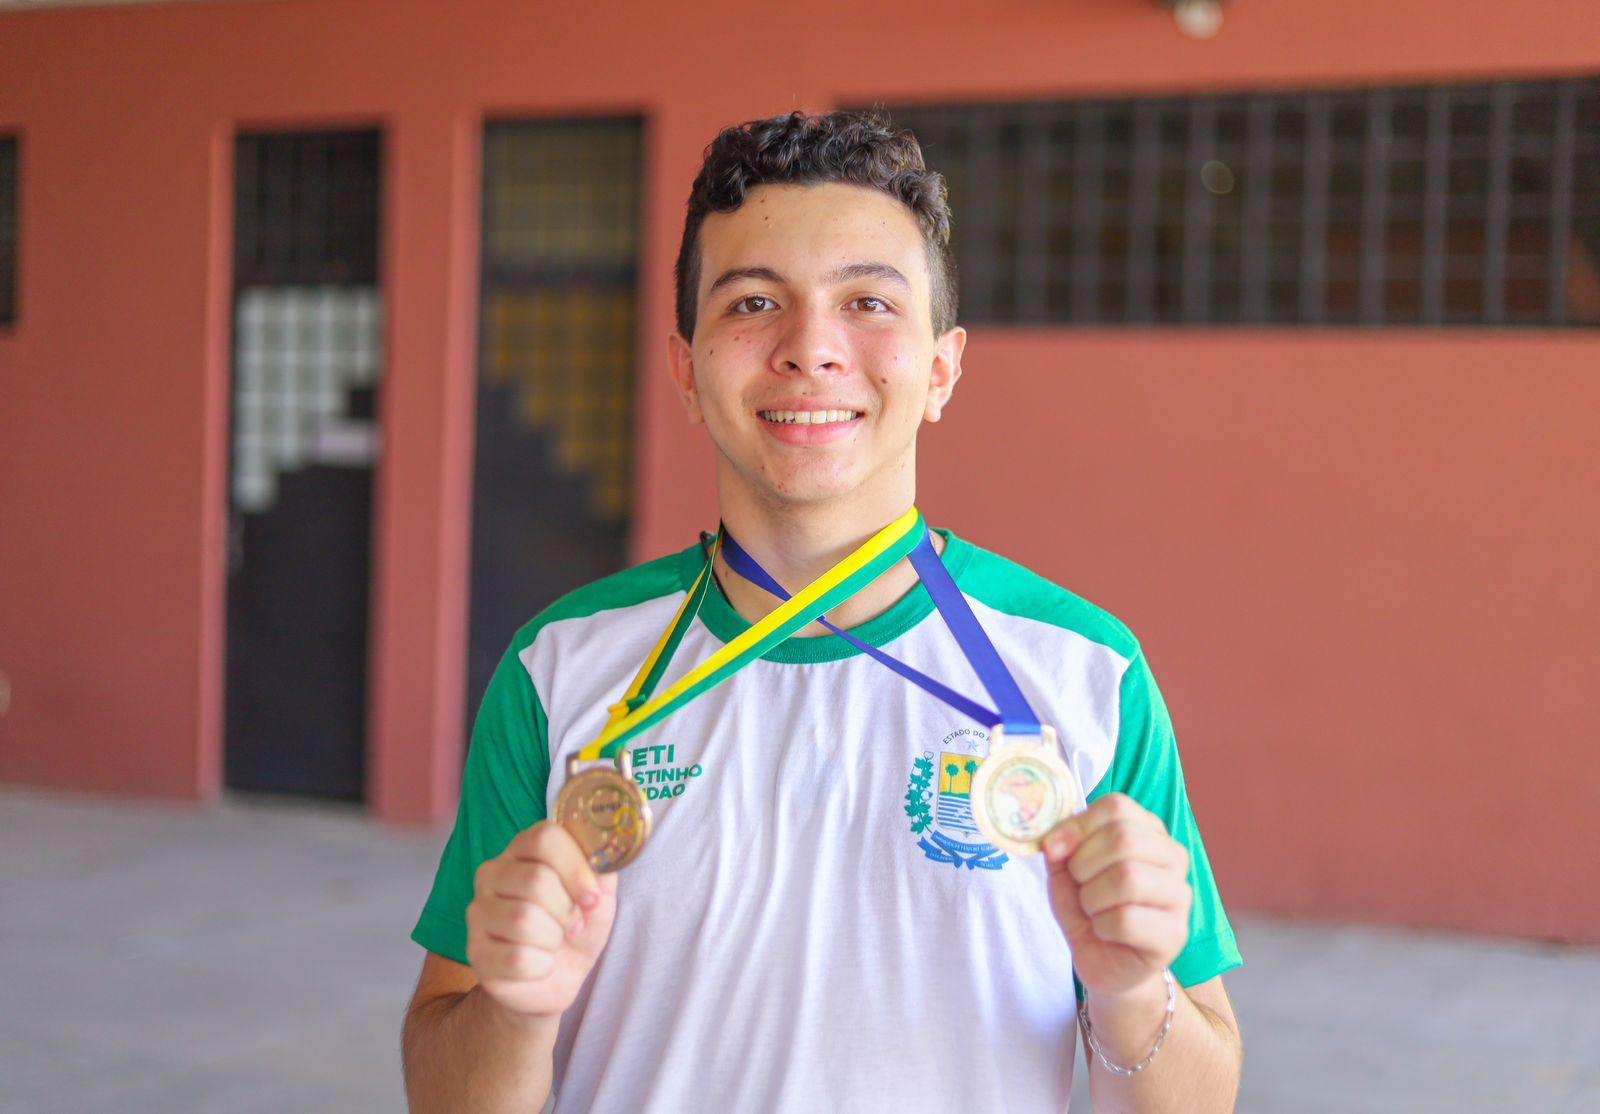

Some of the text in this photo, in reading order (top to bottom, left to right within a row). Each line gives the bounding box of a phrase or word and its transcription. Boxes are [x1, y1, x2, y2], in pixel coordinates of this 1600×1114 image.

[943, 729, 970, 744] ESTADO
[973, 730, 985, 739] DO
[614, 744, 675, 768] ETI
[634, 763, 703, 785] STINHO
[642, 783, 686, 801] DÃO
